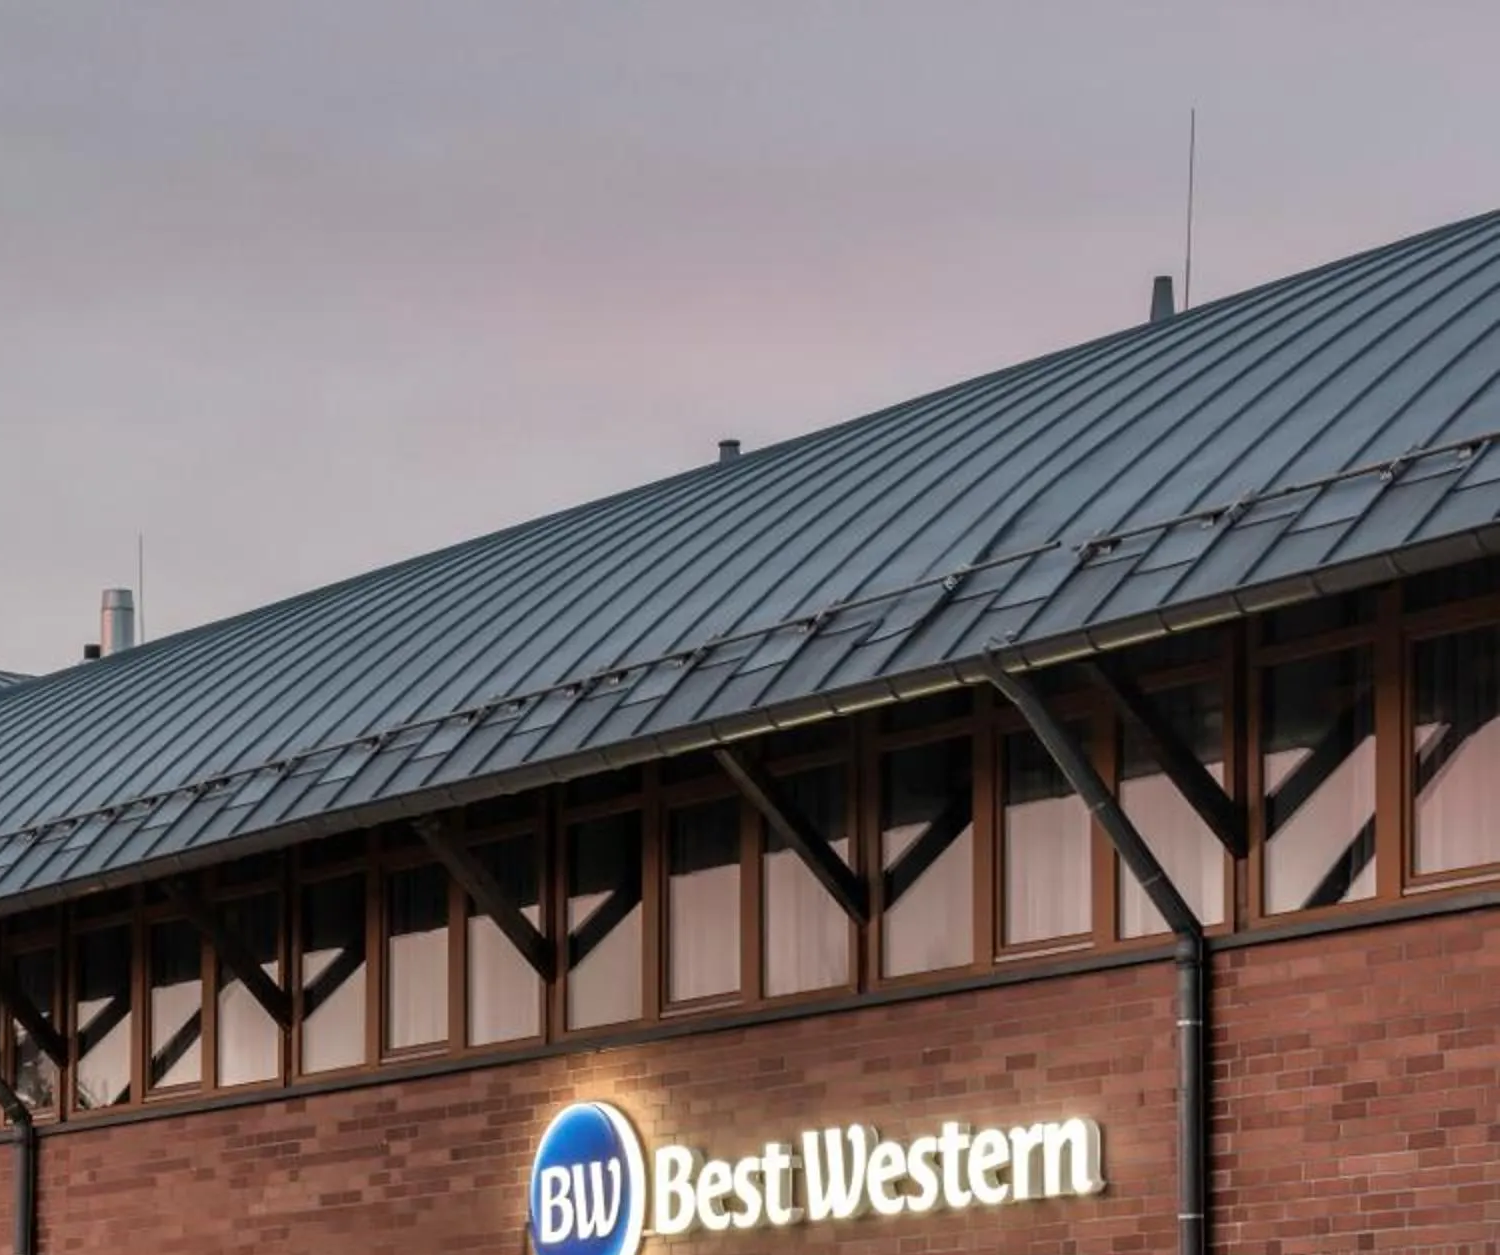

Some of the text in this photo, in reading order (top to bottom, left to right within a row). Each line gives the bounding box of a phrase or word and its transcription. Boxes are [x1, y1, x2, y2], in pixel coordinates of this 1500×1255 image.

[540, 1156, 621, 1244] BW
[653, 1117, 1104, 1235] Best Western
